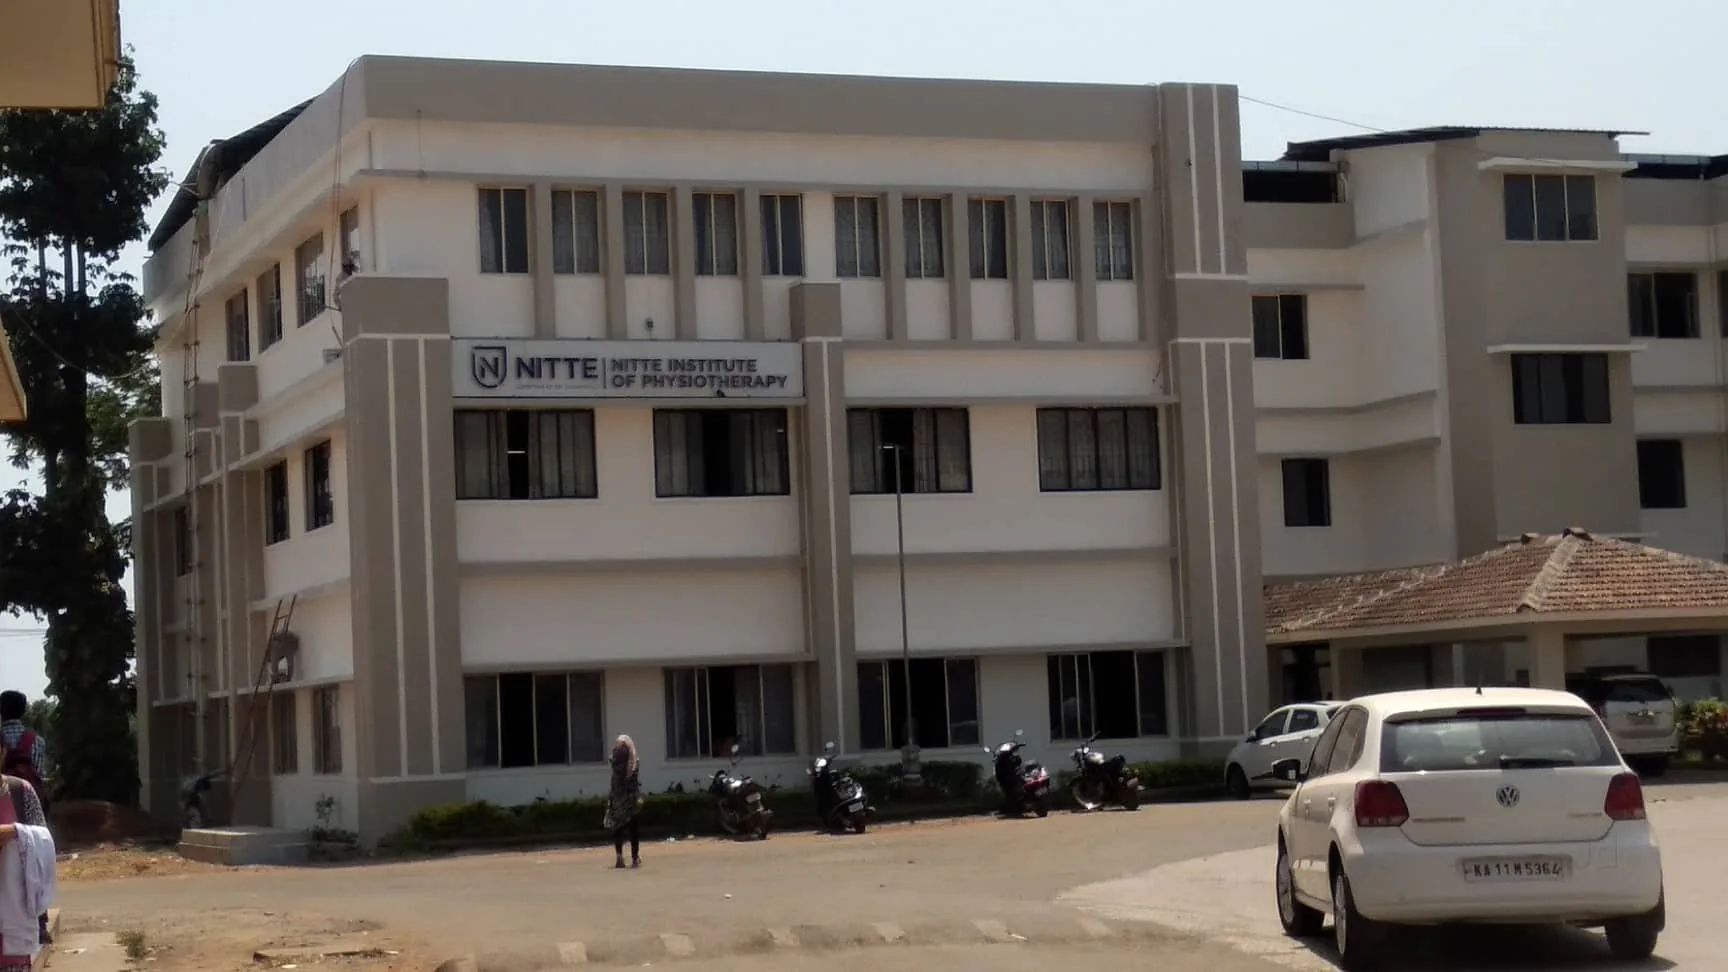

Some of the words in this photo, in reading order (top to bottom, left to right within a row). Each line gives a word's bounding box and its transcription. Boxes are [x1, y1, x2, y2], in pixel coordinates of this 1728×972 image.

[515, 356, 598, 379] NITTE
[611, 358, 662, 372] NITTE
[668, 359, 757, 372] INSTITUTE
[612, 374, 635, 388] OF
[642, 375, 787, 389] PHYSIOTHERAPY
